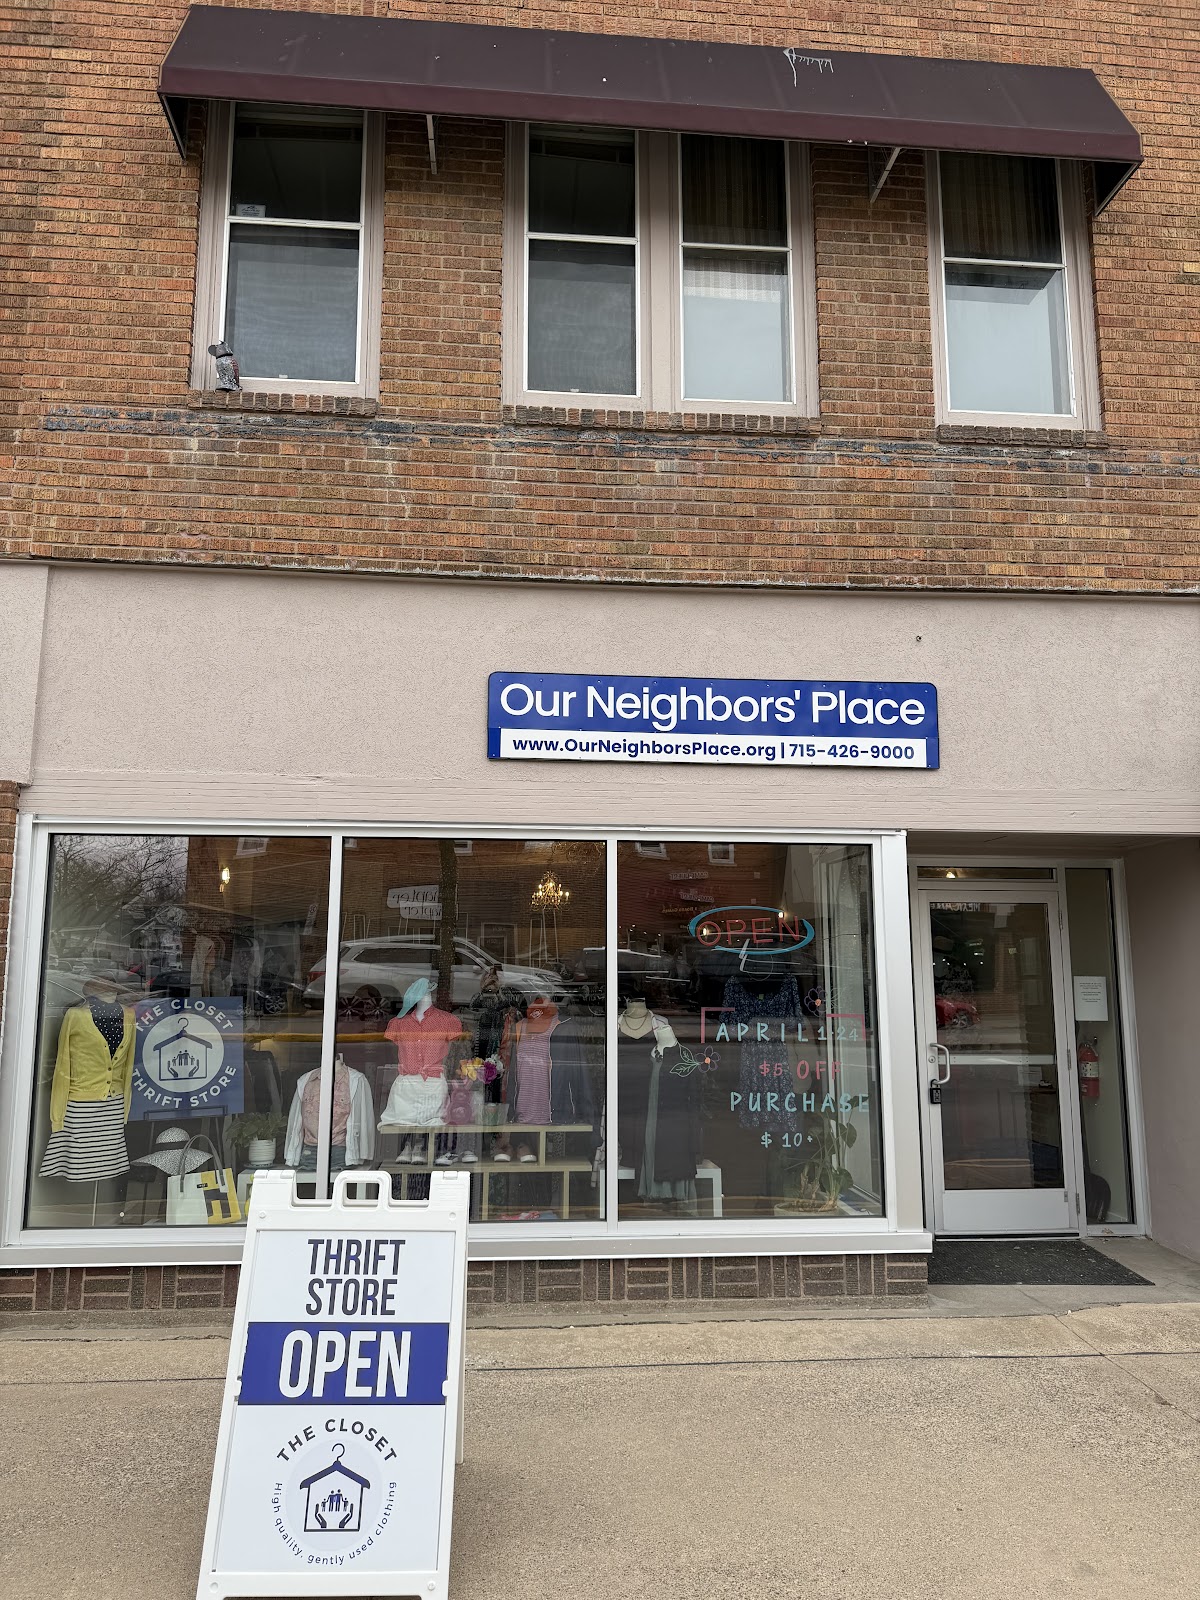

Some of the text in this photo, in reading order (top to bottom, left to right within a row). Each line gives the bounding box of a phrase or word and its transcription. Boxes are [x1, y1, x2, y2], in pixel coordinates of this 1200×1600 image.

[499, 683, 926, 732] Our Neighbors' Place
[512, 737, 776, 762] www.OurNeighborsPlace.org
[789, 743, 915, 761] 715-426-9000
[697, 915, 800, 947] OPEN
[135, 998, 234, 1032] THE CLOSET
[715, 1022, 808, 1042] APRIL
[132, 1065, 237, 1108] THRIFT STORE
[758, 1060, 842, 1080] $5 OFF
[730, 1091, 870, 1113] PURCHASE
[307, 1238, 406, 1275] THRIFT
[305, 1278, 398, 1316] STORE
[278, 1329, 412, 1398] OPEN
[276, 1417, 398, 1463] THE CLOSET
[271, 1482, 283, 1514] High
[307, 1553, 346, 1566] gently
[348, 1536, 375, 1560] used
[375, 1481, 398, 1536] clothing
